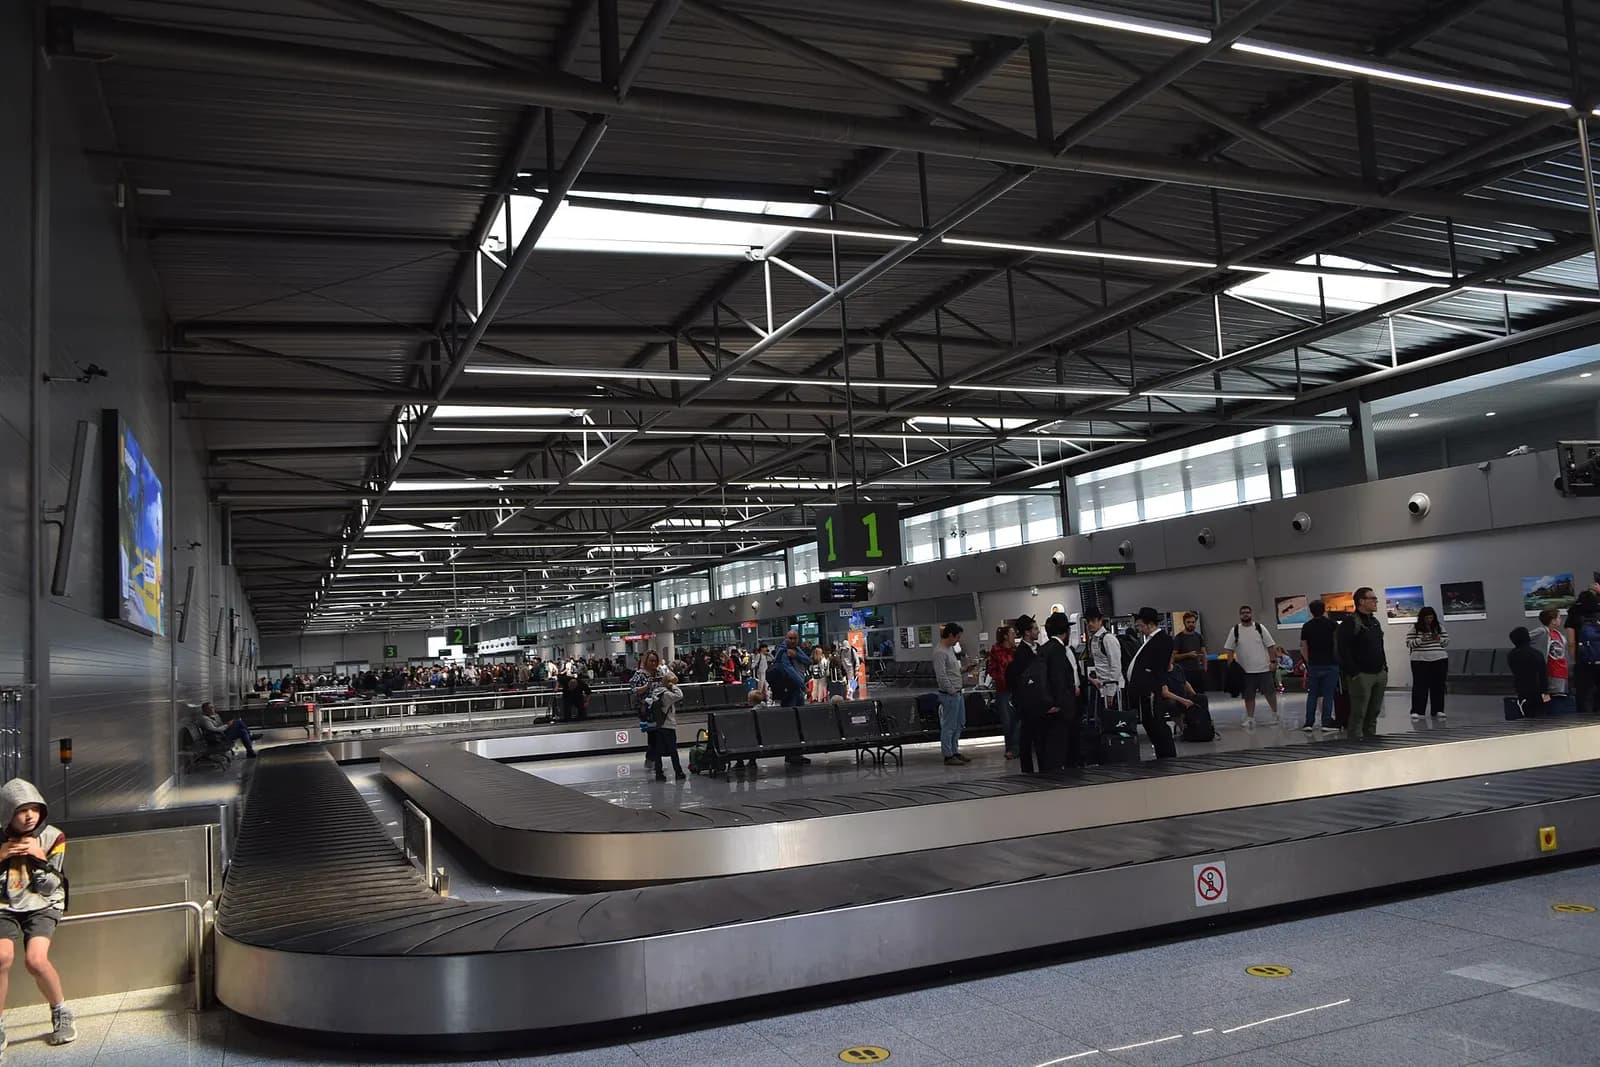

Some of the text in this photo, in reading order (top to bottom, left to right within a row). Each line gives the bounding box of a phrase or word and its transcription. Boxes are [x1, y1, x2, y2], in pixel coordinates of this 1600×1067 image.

[825, 515, 837, 561] 1
[862, 512, 882, 558] 1
[454, 629, 463, 643] 2
[387, 647, 394, 656] 3
